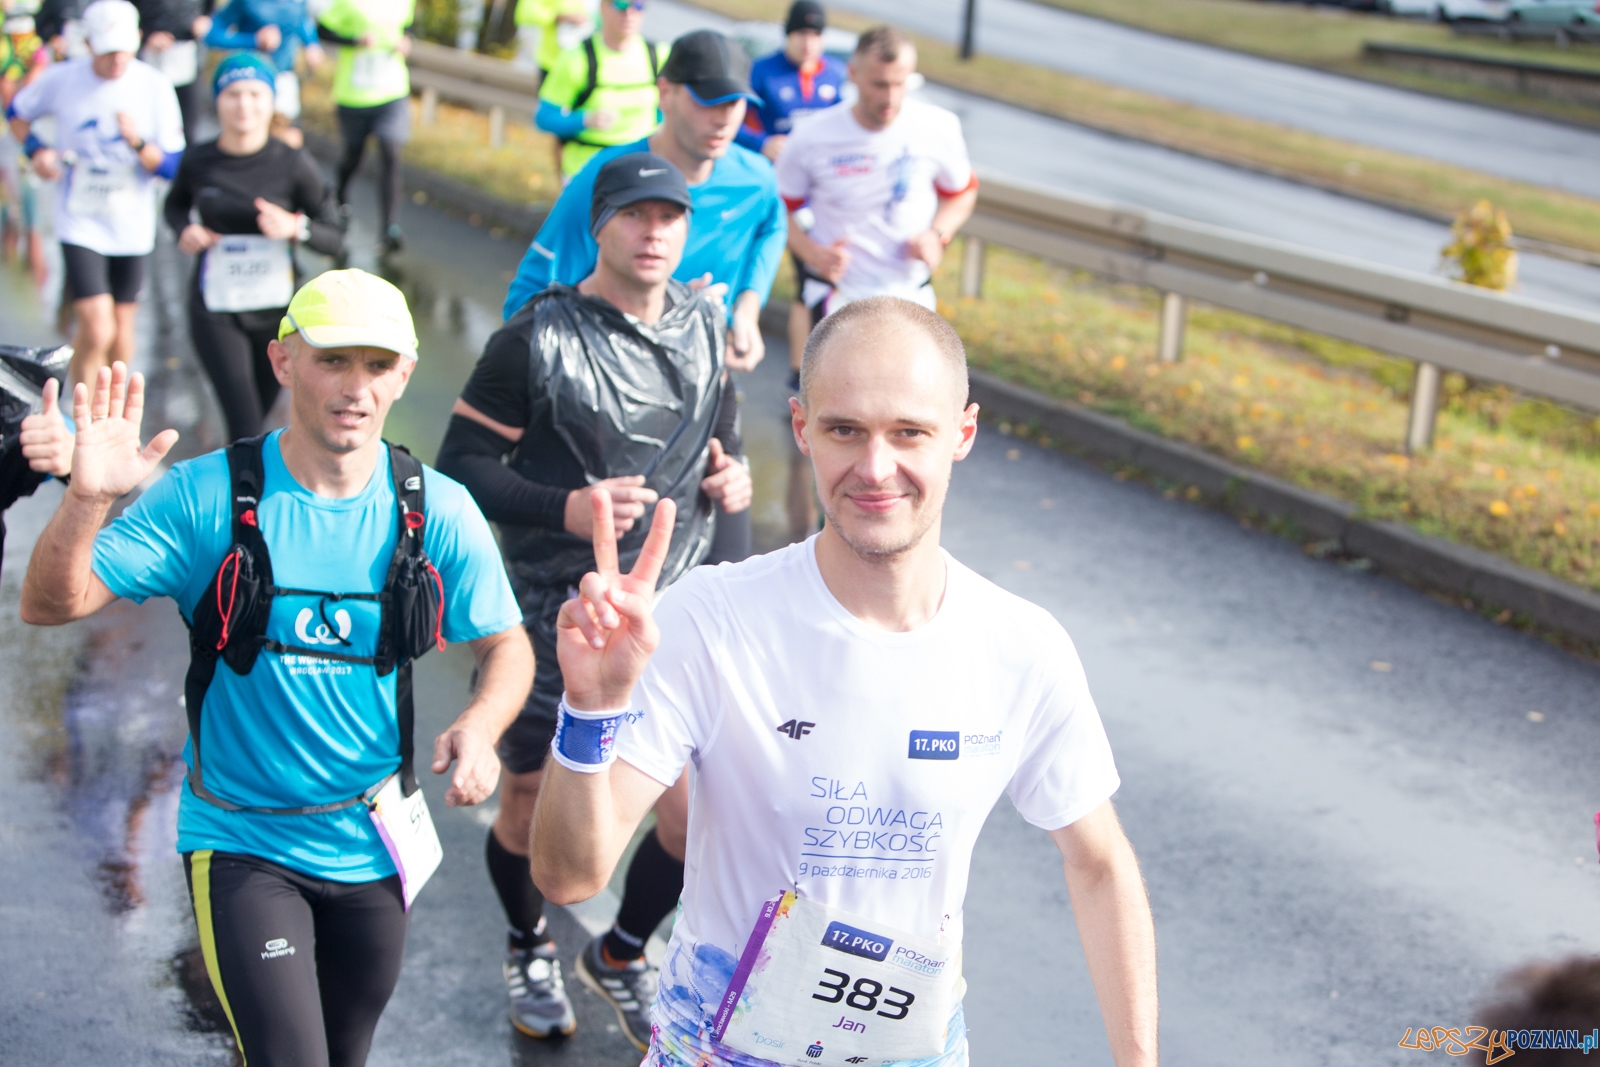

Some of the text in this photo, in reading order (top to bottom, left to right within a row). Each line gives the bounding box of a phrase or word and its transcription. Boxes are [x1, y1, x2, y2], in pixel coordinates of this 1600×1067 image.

[810, 776, 868, 801] SIŁA
[826, 806, 943, 830] ODWAGA
[803, 827, 941, 852] SZYBKOŚĆ
[798, 862, 932, 879] 9 października 2016
[892, 955, 942, 975] maraton
[812, 967, 915, 1020] 383
[832, 1016, 867, 1034] Jan
